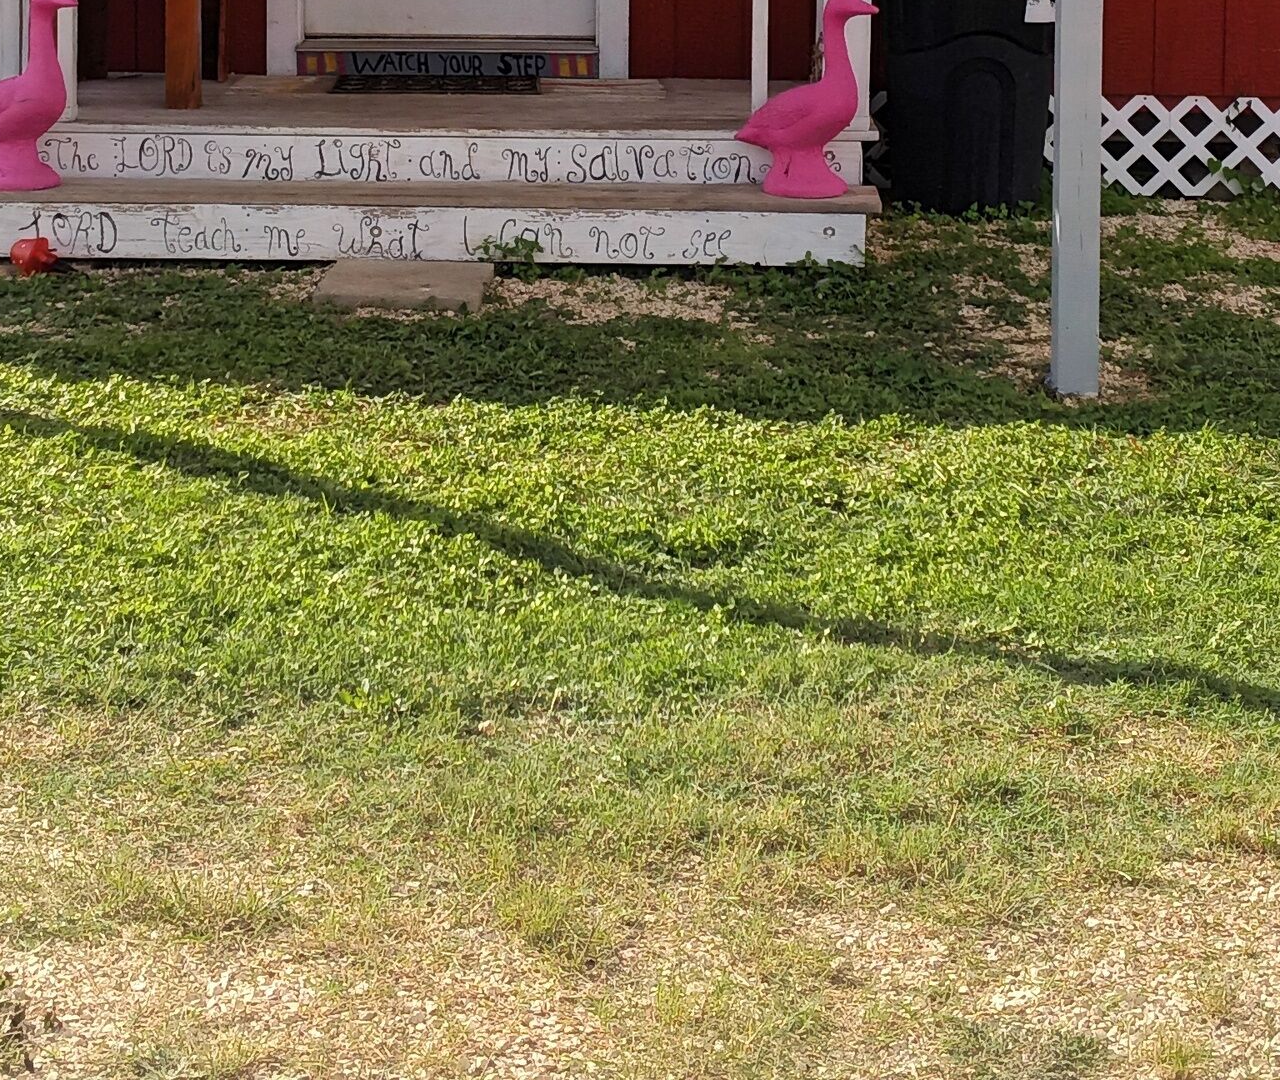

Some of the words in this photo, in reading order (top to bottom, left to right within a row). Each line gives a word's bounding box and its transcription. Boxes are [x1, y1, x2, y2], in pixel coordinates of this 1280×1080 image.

[351, 52, 430, 74] WATCH
[438, 54, 483, 76] YOUR
[497, 53, 546, 77] STEP
[45, 137, 99, 172] The
[111, 134, 193, 177] LORD
[420, 142, 480, 180] and
[264, 225, 309, 257] me
[588, 226, 665, 259] not
[682, 229, 732, 258] see
